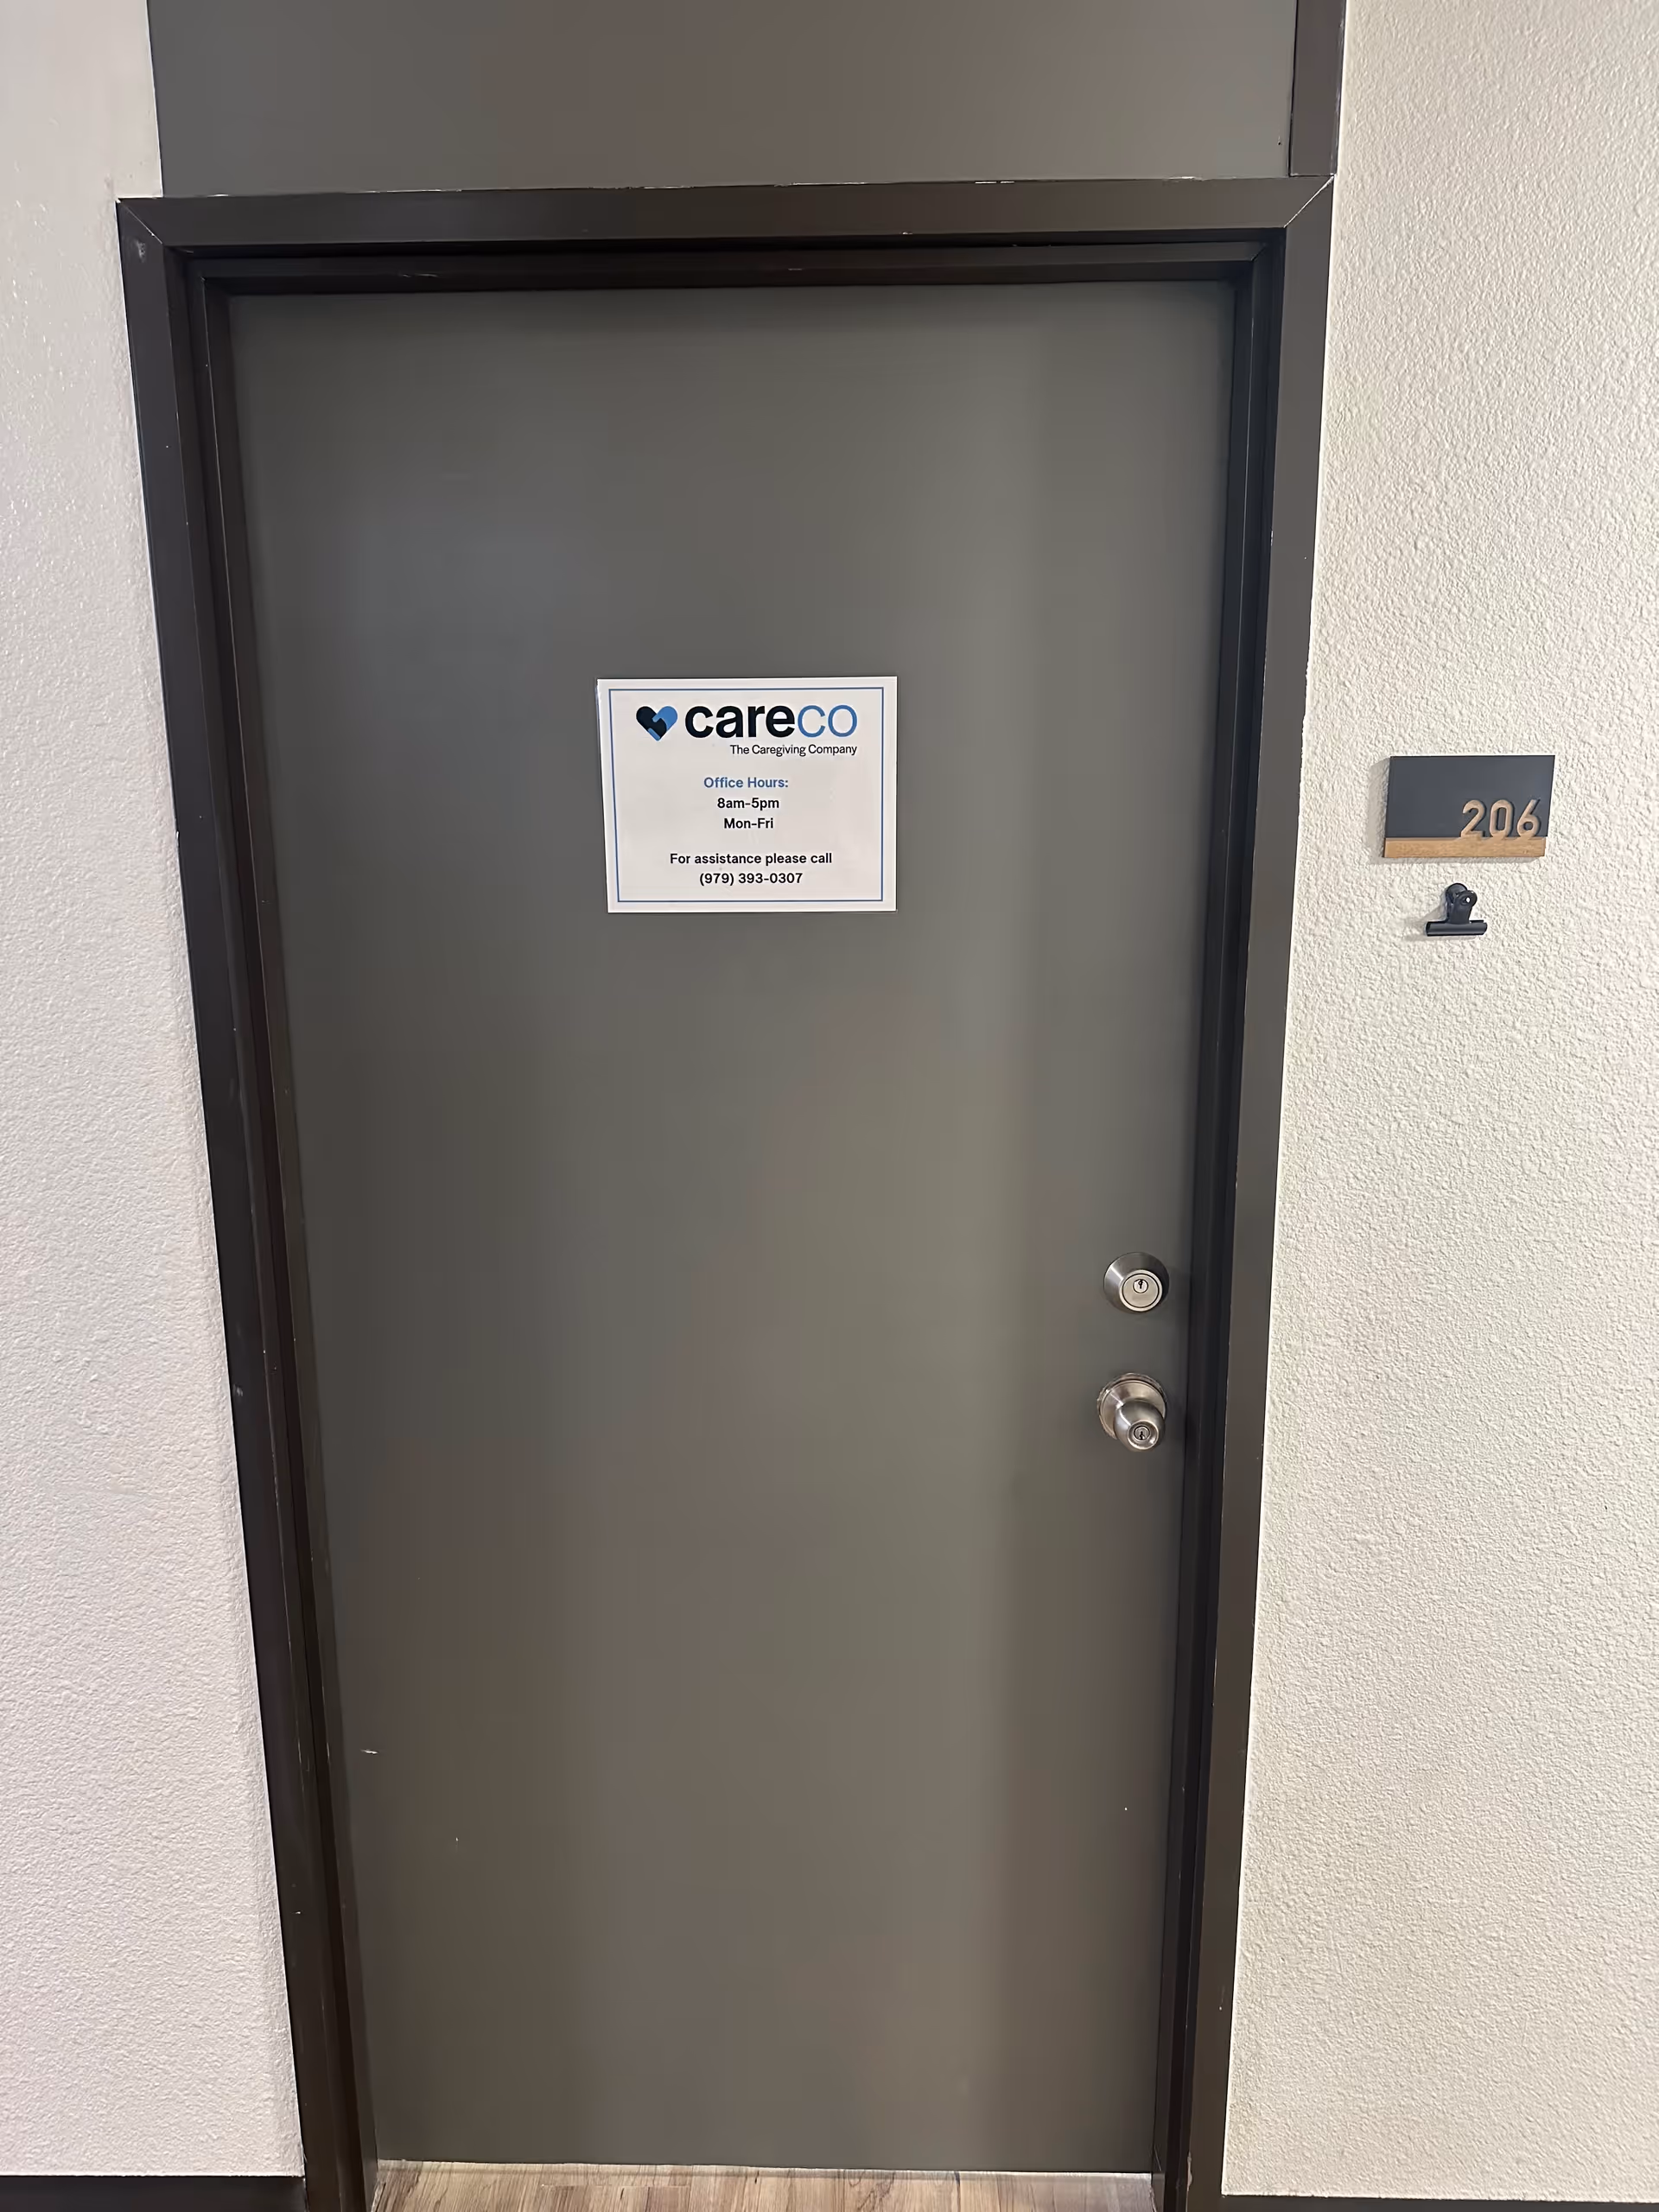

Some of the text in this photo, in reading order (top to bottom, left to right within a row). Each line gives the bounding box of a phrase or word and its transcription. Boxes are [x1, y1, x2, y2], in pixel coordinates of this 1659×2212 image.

[684, 704, 858, 739] careco
[729, 743, 858, 758] The Caregiving Company
[703, 776, 789, 789] Office Hours:
[716, 797, 779, 811] 8am-5pm
[723, 817, 774, 830] Mon-Fri
[1461, 798, 1540, 837] 206
[670, 852, 832, 867] For assistance please call
[699, 872, 804, 887] (979) 393-0307
